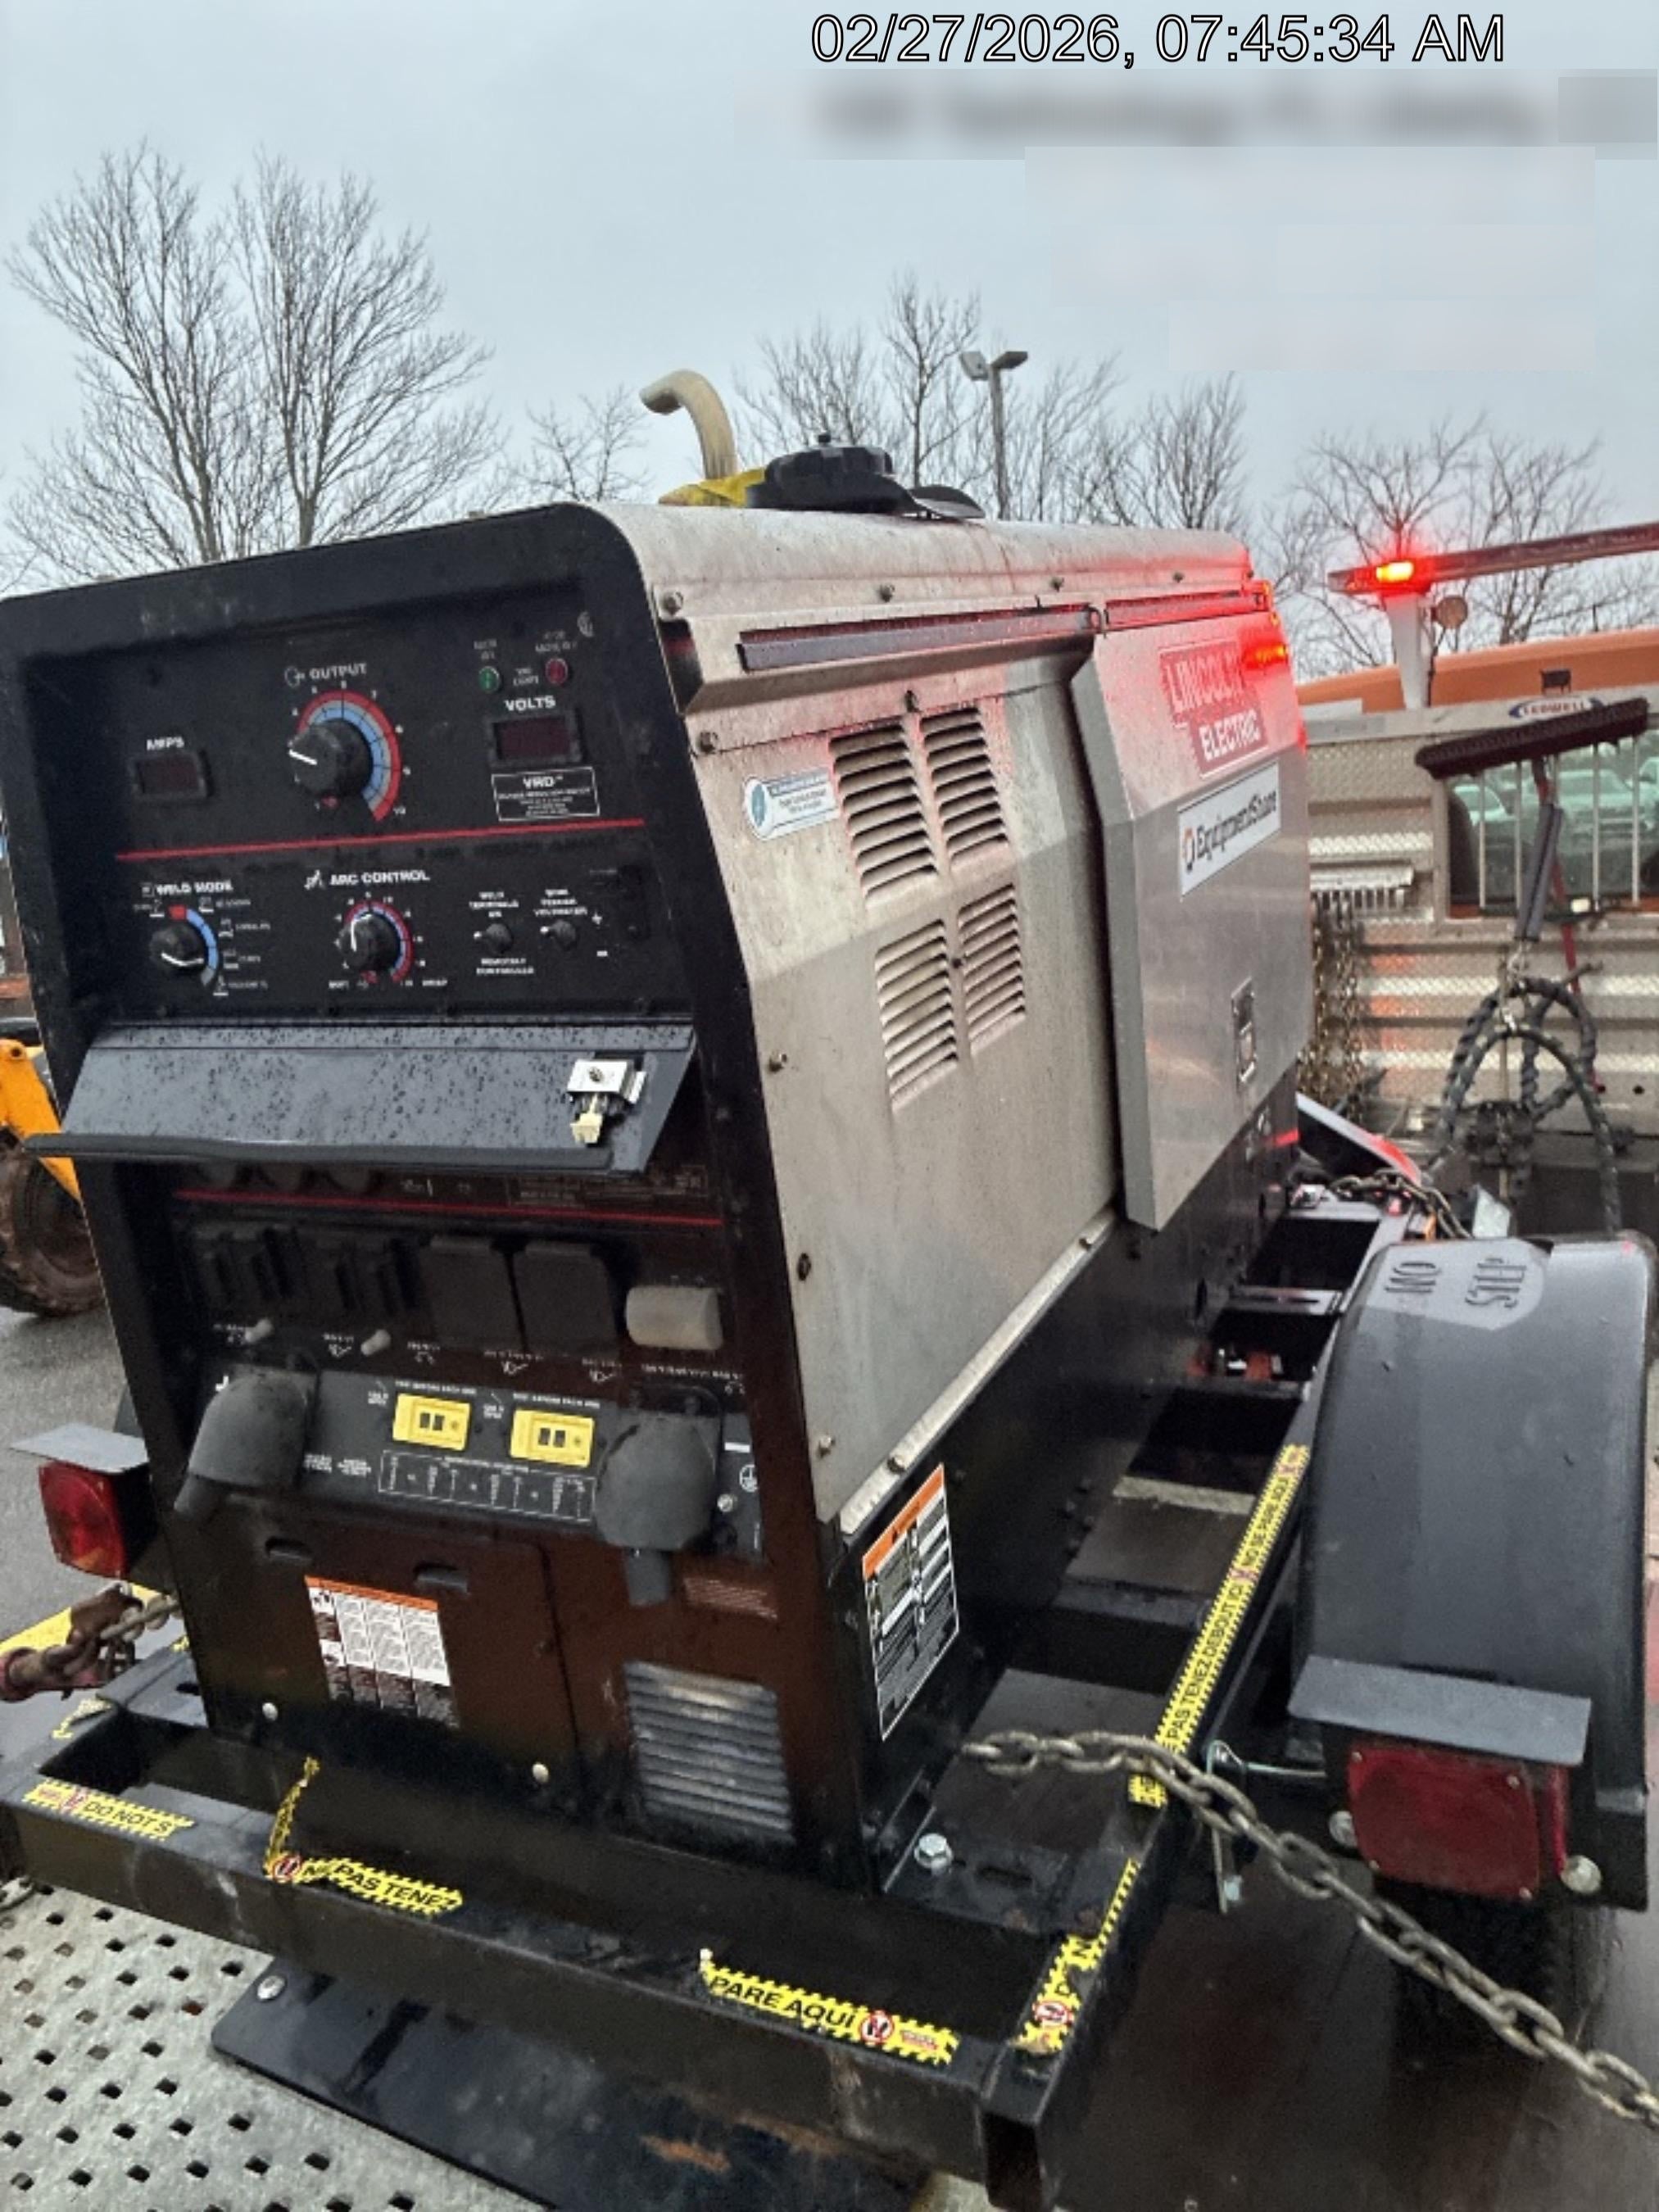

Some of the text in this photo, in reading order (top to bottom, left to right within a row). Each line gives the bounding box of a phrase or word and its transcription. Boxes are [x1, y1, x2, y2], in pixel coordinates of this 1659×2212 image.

[309, 663, 367, 680] OUTPUT
[504, 695, 556, 712] VOLTS
[1199, 708, 1262, 762] ELECTRIC
[1197, 790, 1276, 861] EquipmentShare
[360, 869, 430, 885] CONTROL
[84, 1801, 114, 1816] DO
[112, 1808, 157, 1827] NOT
[333, 1864, 382, 1891] PAS
[709, 1974, 857, 2028] PARE AQUI
